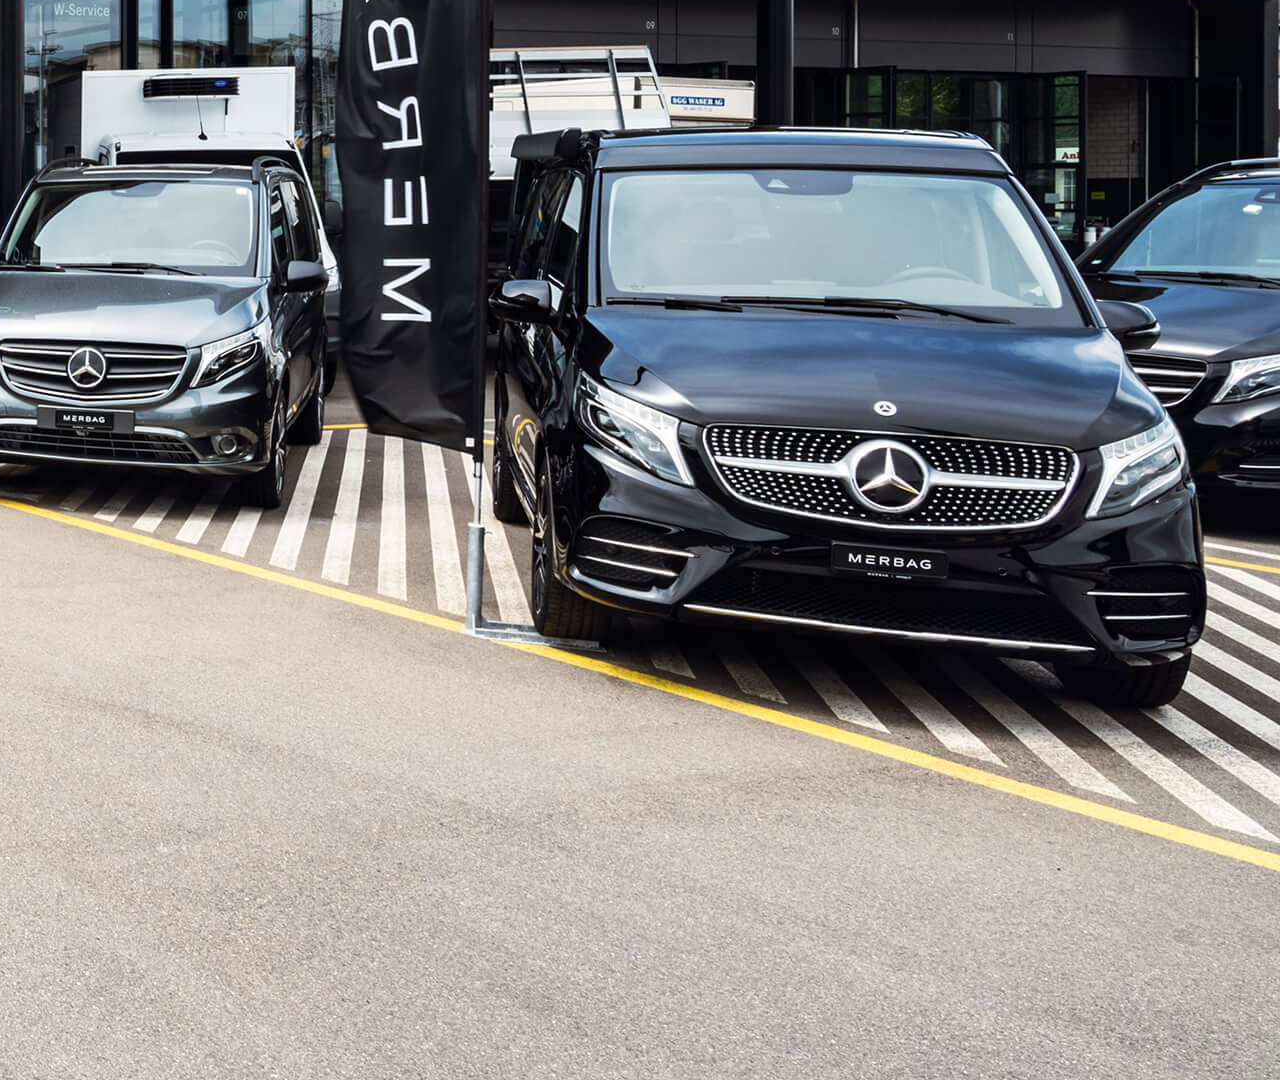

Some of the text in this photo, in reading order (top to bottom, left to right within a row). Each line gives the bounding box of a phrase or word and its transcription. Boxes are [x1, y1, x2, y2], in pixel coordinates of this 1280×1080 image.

[53, 2, 111, 17] W-Service
[646, 20, 656, 30] 09
[63, 414, 106, 424] MERBAG
[848, 553, 933, 570] MERBAG
